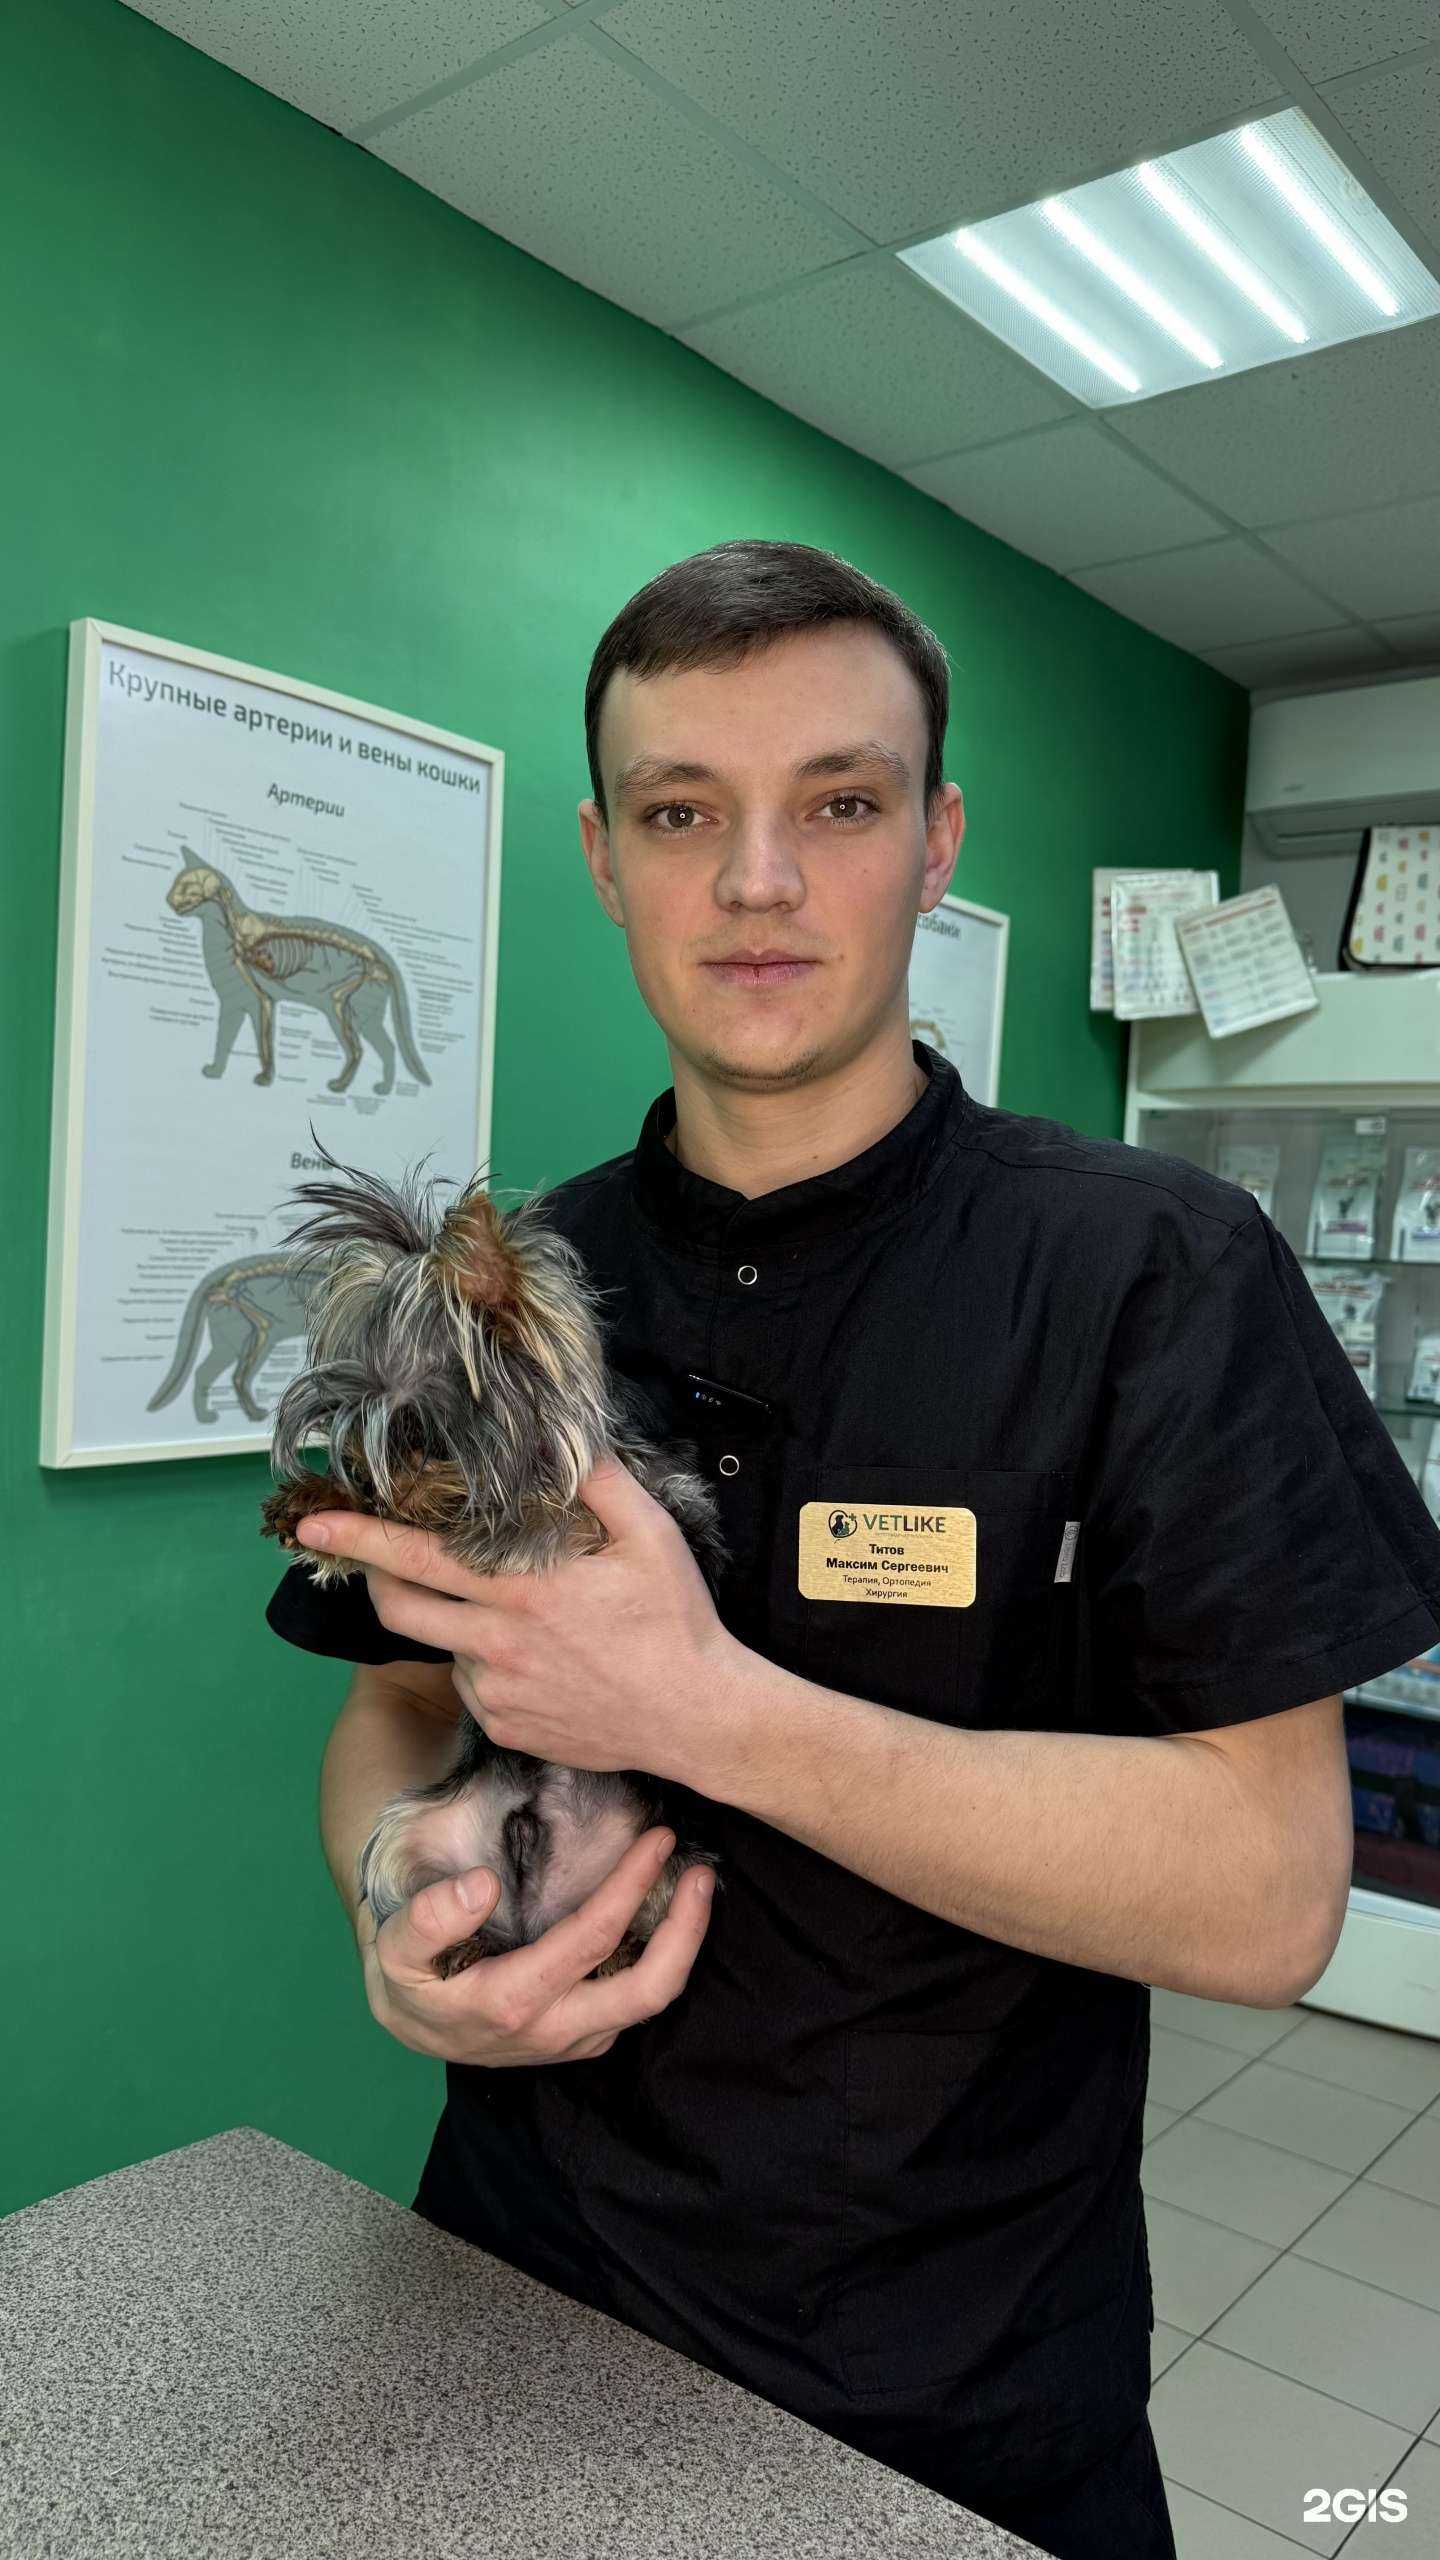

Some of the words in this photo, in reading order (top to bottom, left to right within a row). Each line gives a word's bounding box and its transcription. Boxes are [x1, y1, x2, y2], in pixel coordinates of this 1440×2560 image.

[109, 660, 227, 718] Крупные
[233, 702, 333, 749] артерии
[340, 736, 352, 756] и
[358, 741, 412, 773] вены
[416, 759, 481, 795] кошки
[267, 782, 346, 818] Артерии
[863, 1514, 946, 1533] VETLIKE
[869, 1543, 905, 1555] Титов
[826, 1557, 878, 1571] Максим
[881, 1560, 949, 1574] Сергеевич
[843, 1574, 880, 1587] Терапия,
[882, 1577, 931, 1588] Ортопедия
[865, 1588, 908, 1599] Хирургия
